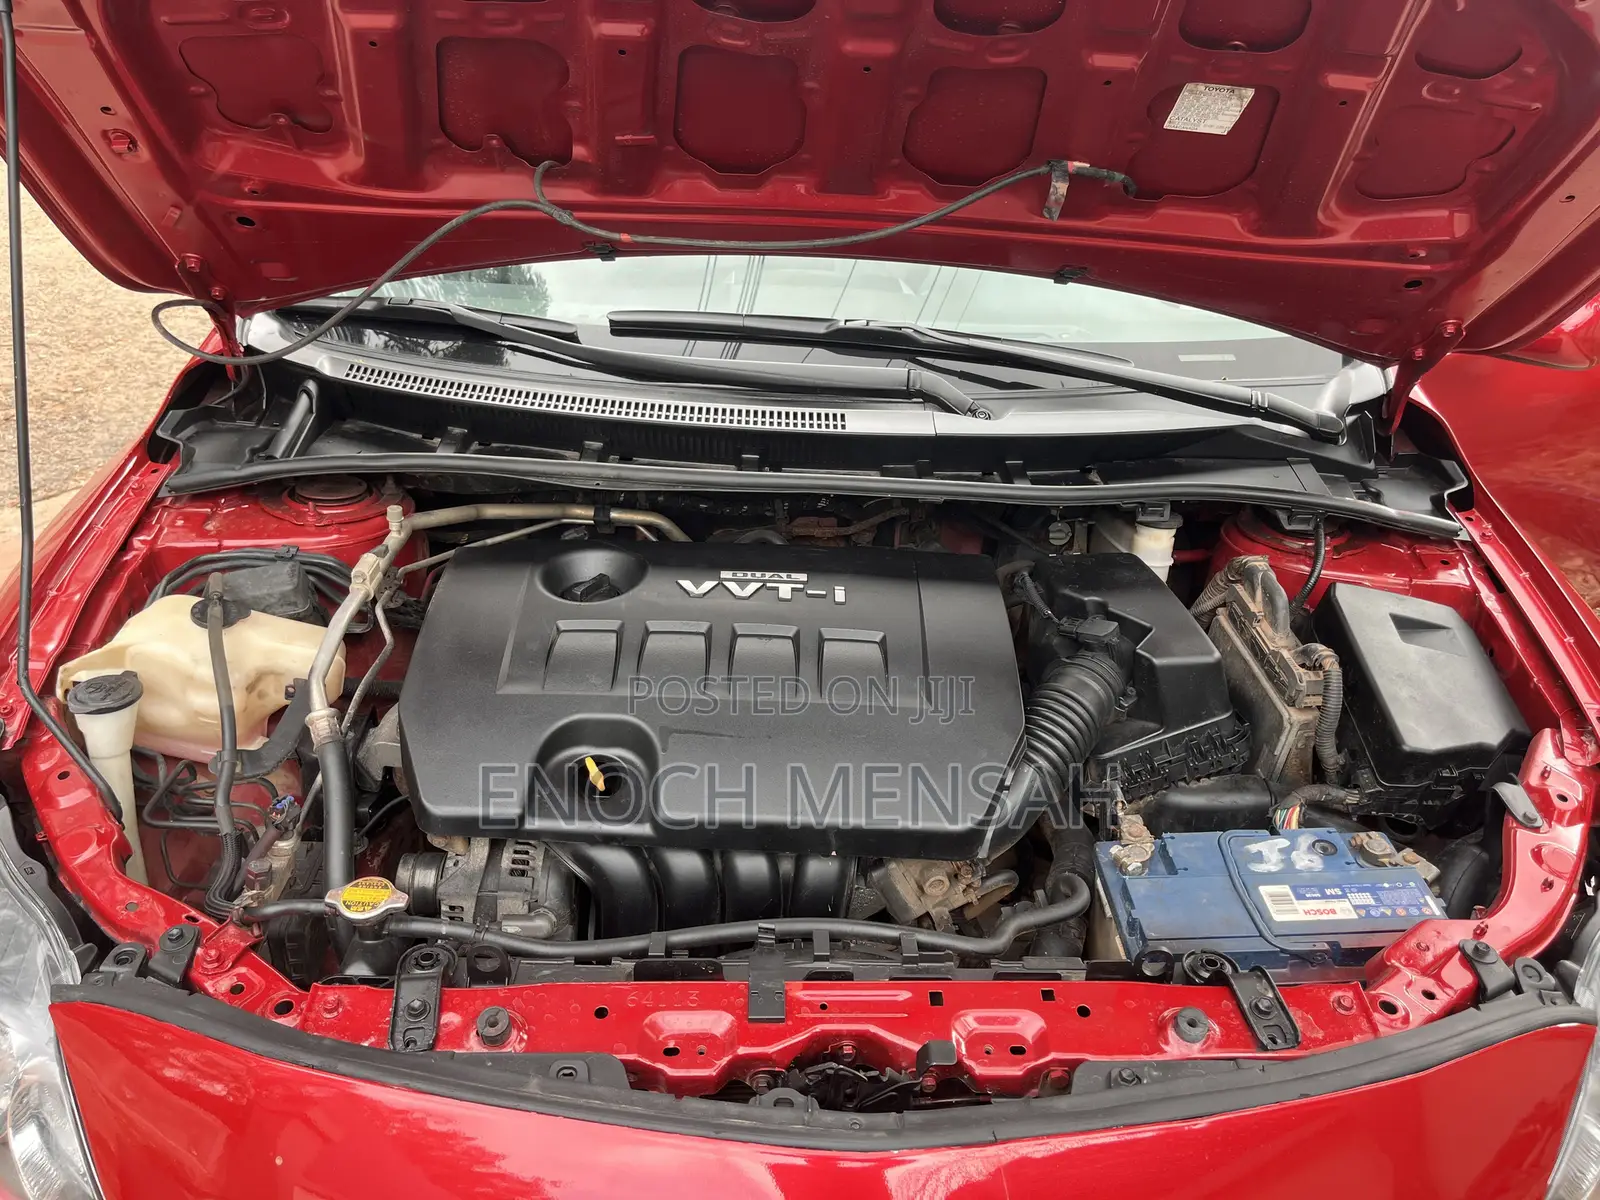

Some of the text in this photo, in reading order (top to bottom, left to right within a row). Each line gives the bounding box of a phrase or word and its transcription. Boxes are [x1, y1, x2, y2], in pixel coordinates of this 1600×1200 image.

[1203, 85, 1235, 94] TOYOTA
[1169, 115, 1207, 124] CATALYST
[731, 572, 801, 580] DUAL
[1303, 908, 1338, 917] BOSCH
